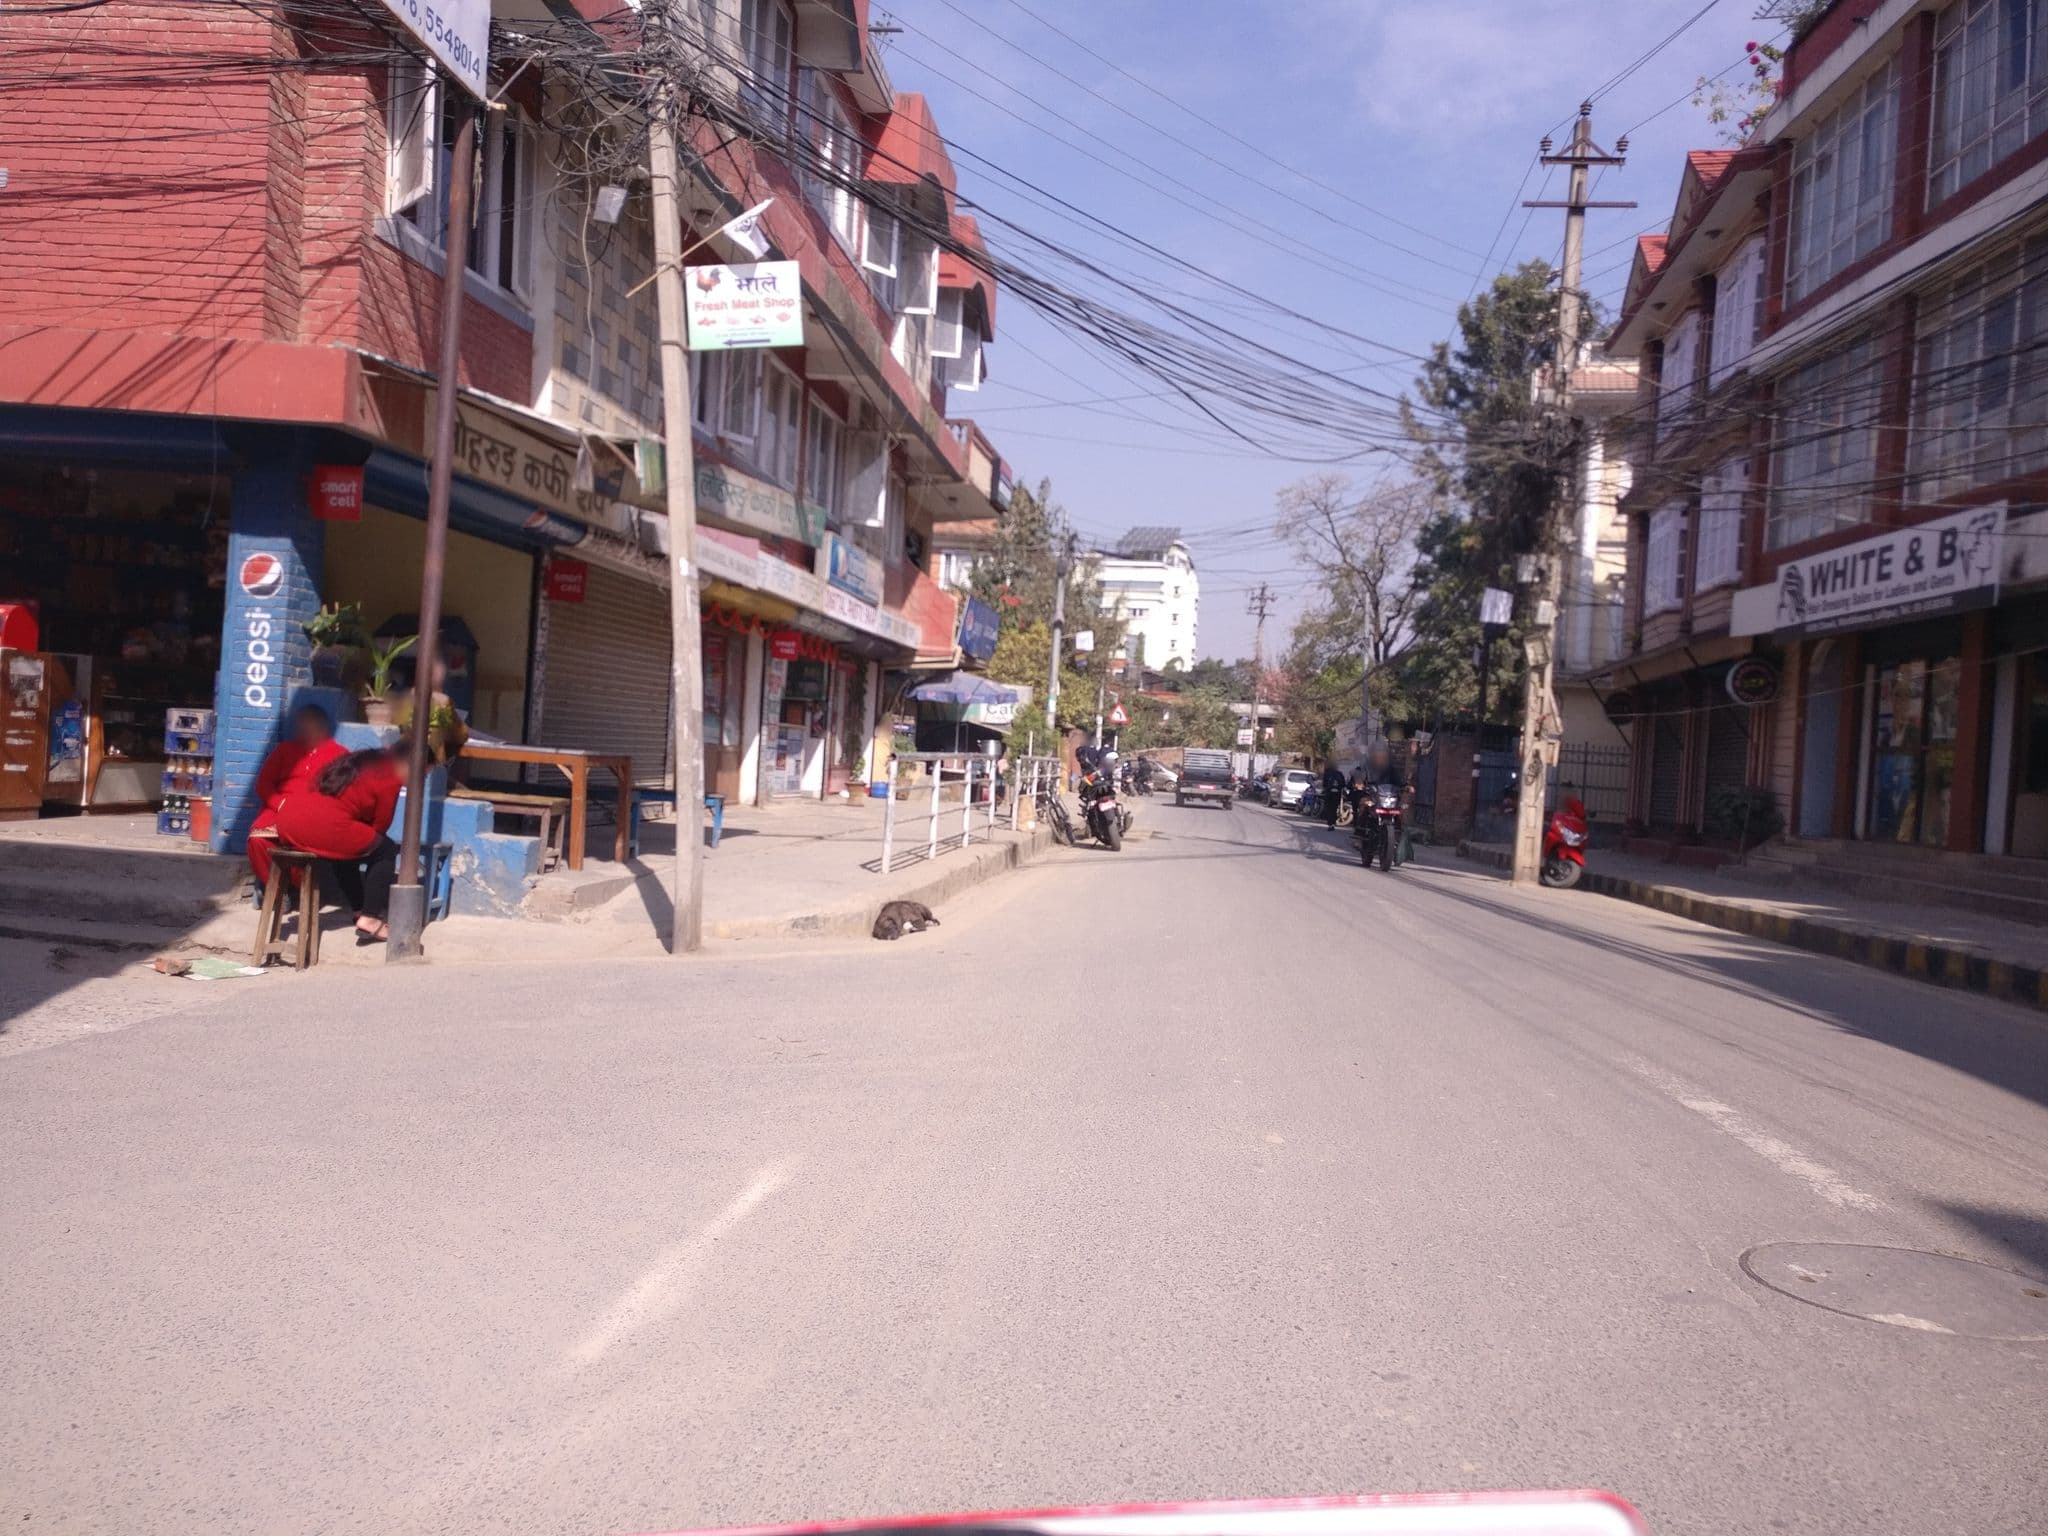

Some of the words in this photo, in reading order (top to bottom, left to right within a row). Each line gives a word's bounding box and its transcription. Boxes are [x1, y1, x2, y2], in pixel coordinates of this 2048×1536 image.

[695, 301, 728, 312] Fresh
[731, 299, 760, 310] Meat
[763, 297, 795, 309] Shop
[320, 481, 357, 494] smart
[329, 495, 355, 508] cell
[1810, 544, 1895, 598] WHITE
[1904, 536, 1925, 576] &
[1885, 582, 1910, 599] Ladies
[1913, 577, 1928, 594] and
[1930, 572, 1955, 591] Gents
[245, 605, 275, 709] pepsi
